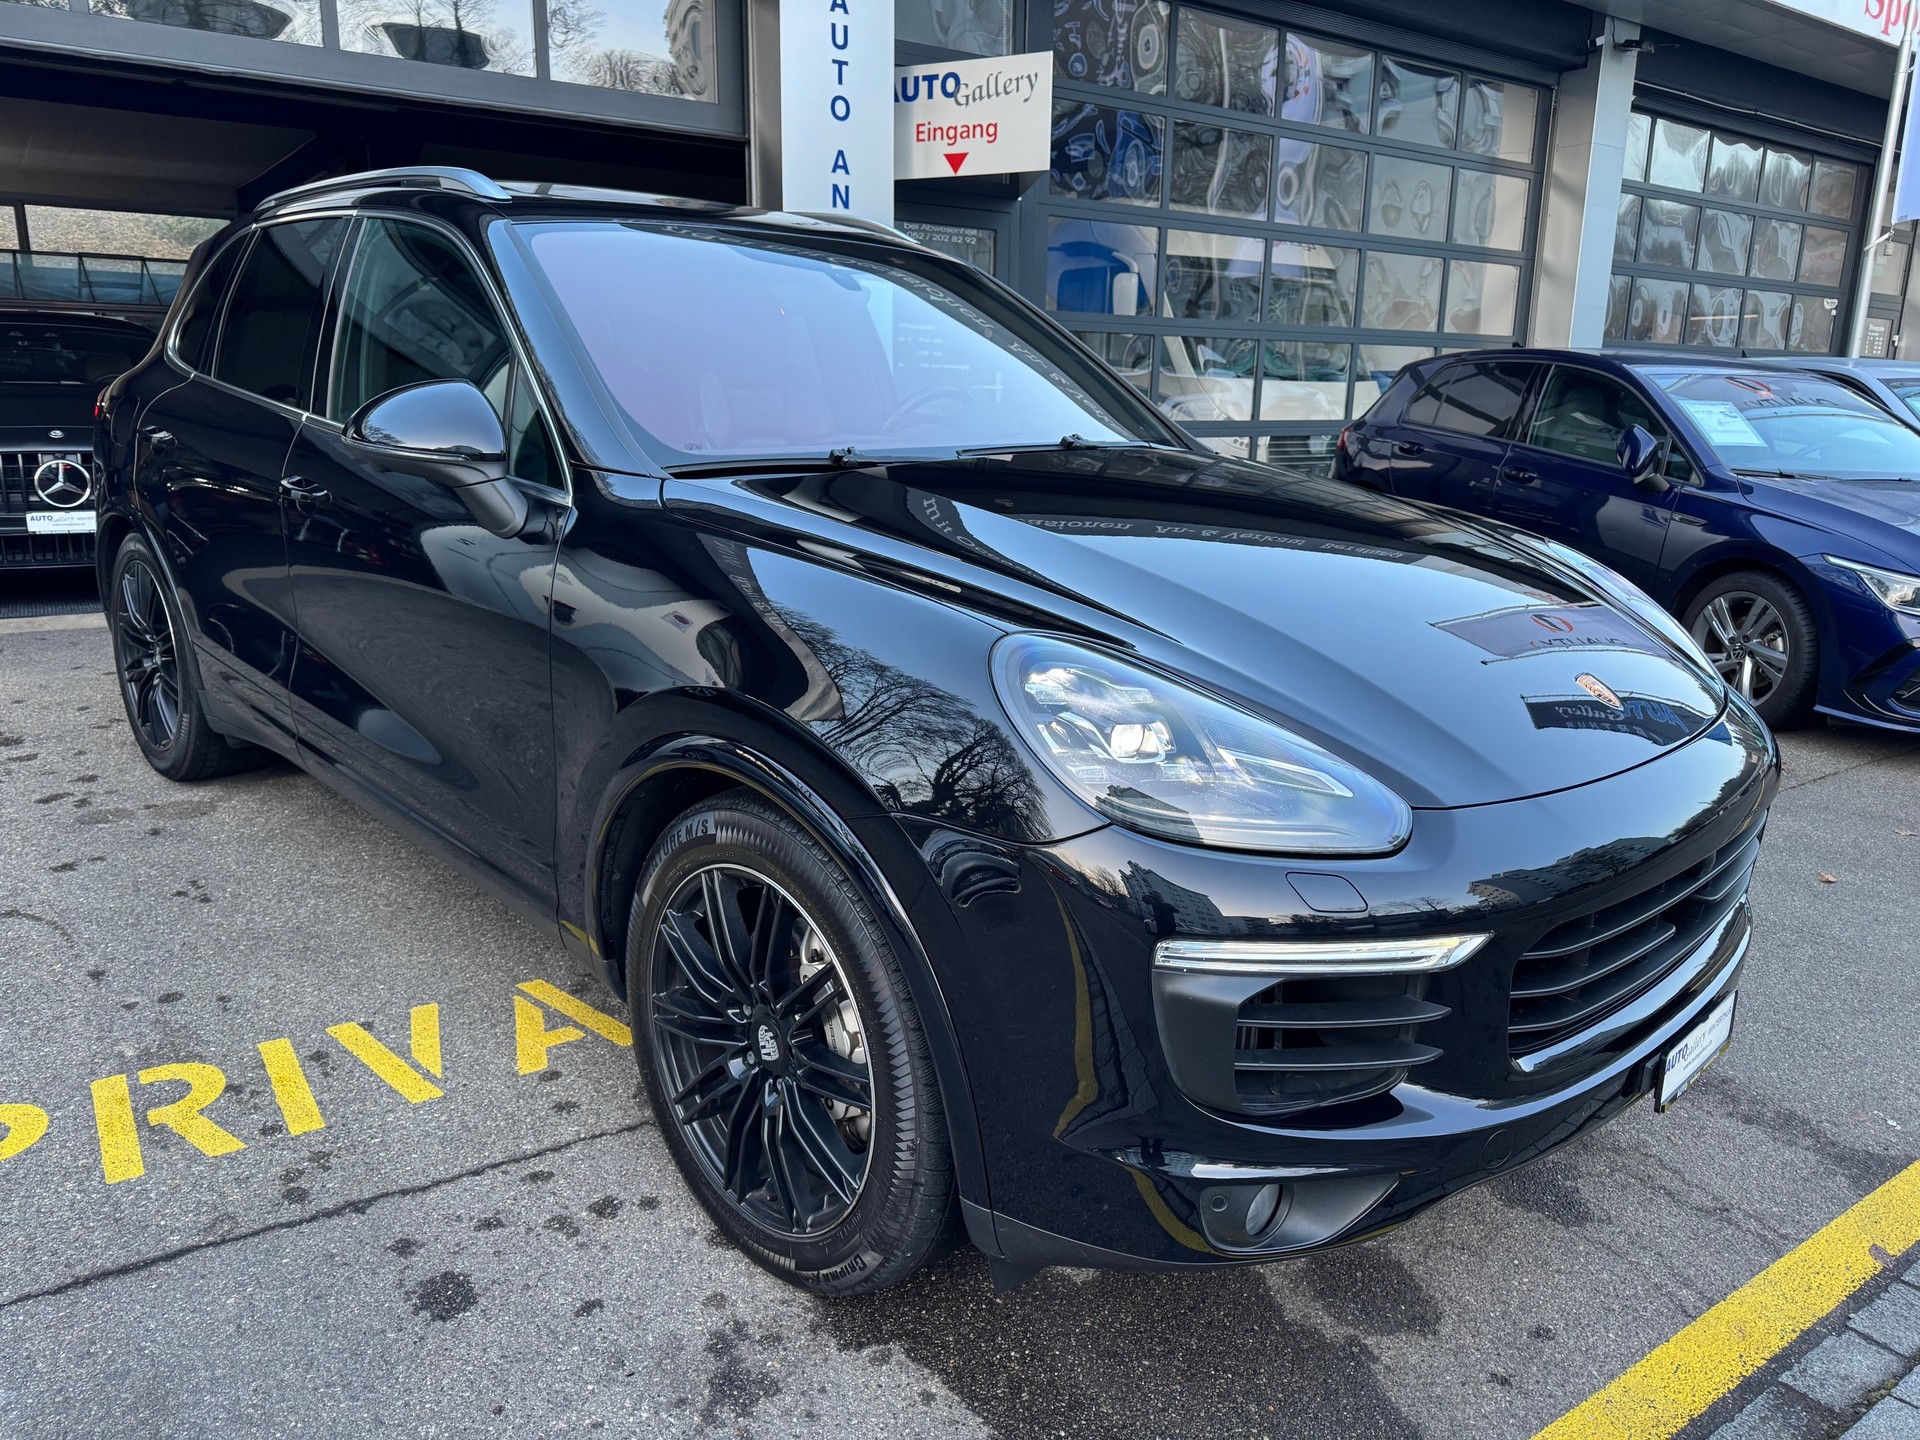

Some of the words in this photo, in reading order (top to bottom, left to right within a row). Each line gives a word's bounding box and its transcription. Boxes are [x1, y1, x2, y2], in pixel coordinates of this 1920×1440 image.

[953, 71, 1038, 107] Gallery
[915, 121, 998, 146] Eingang
[932, 233, 949, 242] 202
[951, 235, 963, 243] 82
[965, 236, 977, 245] 92
[1665, 1043, 1689, 1073] AUTO
